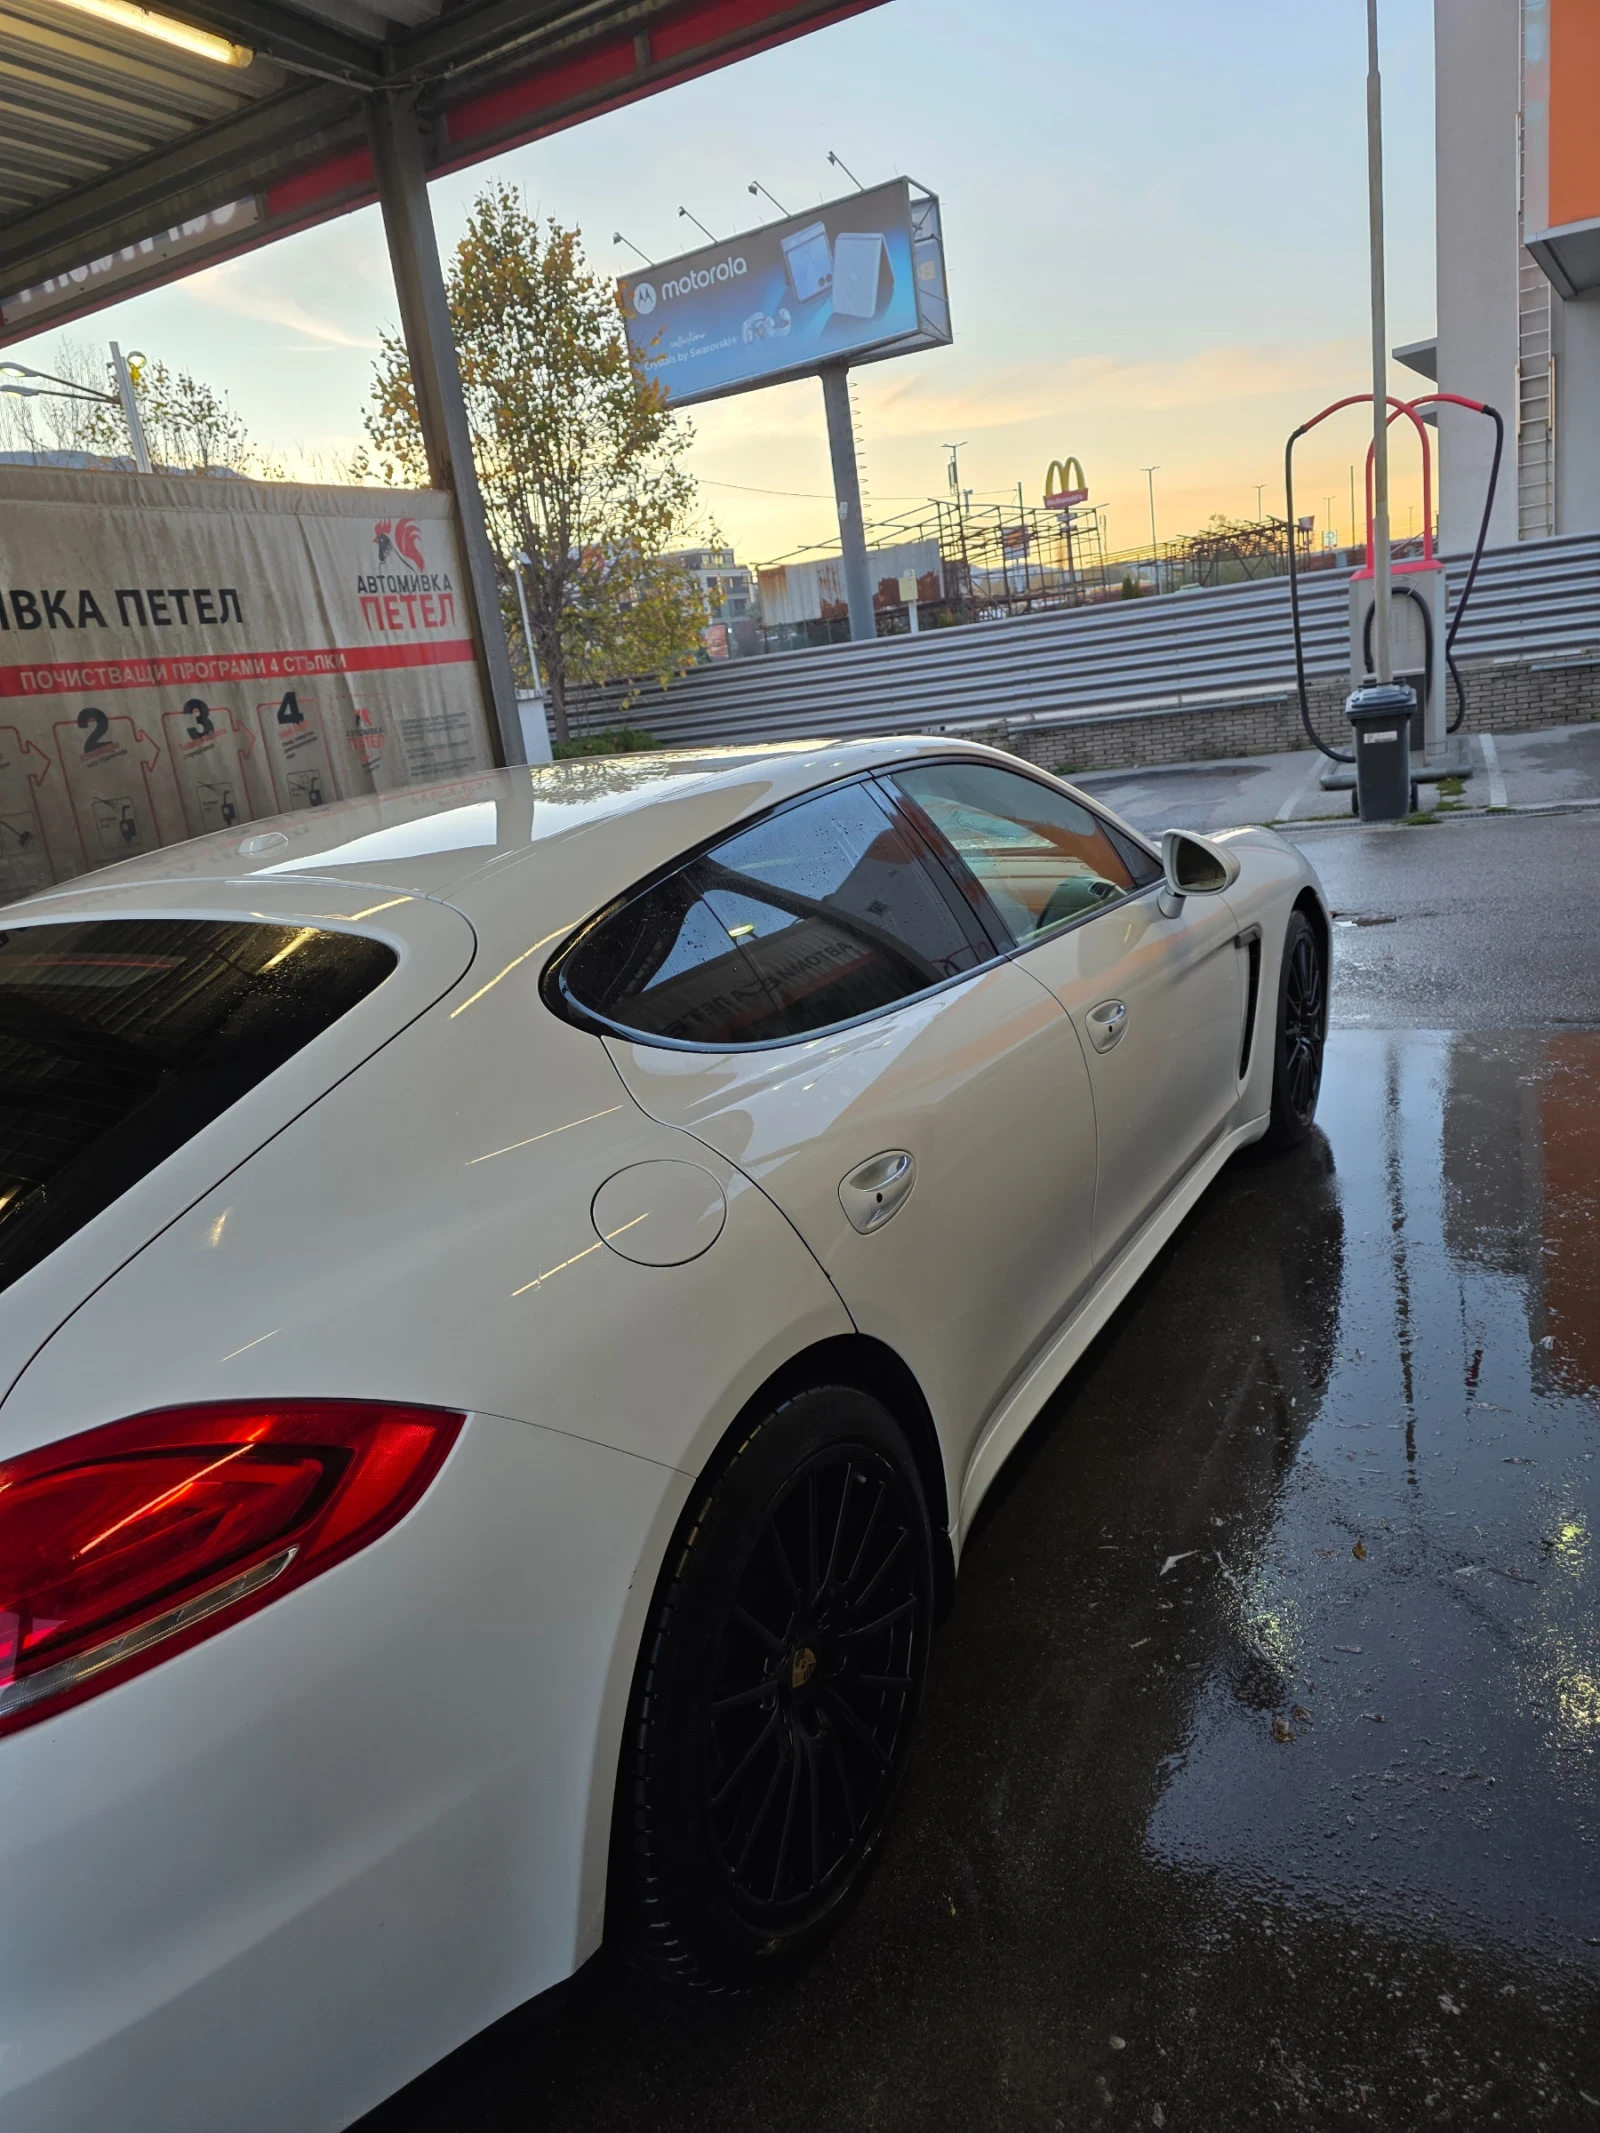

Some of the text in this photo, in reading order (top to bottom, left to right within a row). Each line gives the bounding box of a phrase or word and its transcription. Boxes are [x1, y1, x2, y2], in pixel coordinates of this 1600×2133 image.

[661, 256, 748, 301] motorola
[677, 350, 689, 362] by
[357, 574, 453, 594] АВТОМИВКА
[115, 589, 243, 627] ПЕТЕЛ
[359, 593, 455, 631] ПЕТЕЛ
[20, 653, 347, 690] ПОЧИСТВАЩИ ПРОГРАМИ 4 СТЪПКИ
[183, 699, 215, 740] 3
[277, 691, 304, 725] 4
[77, 707, 113, 754] 2
